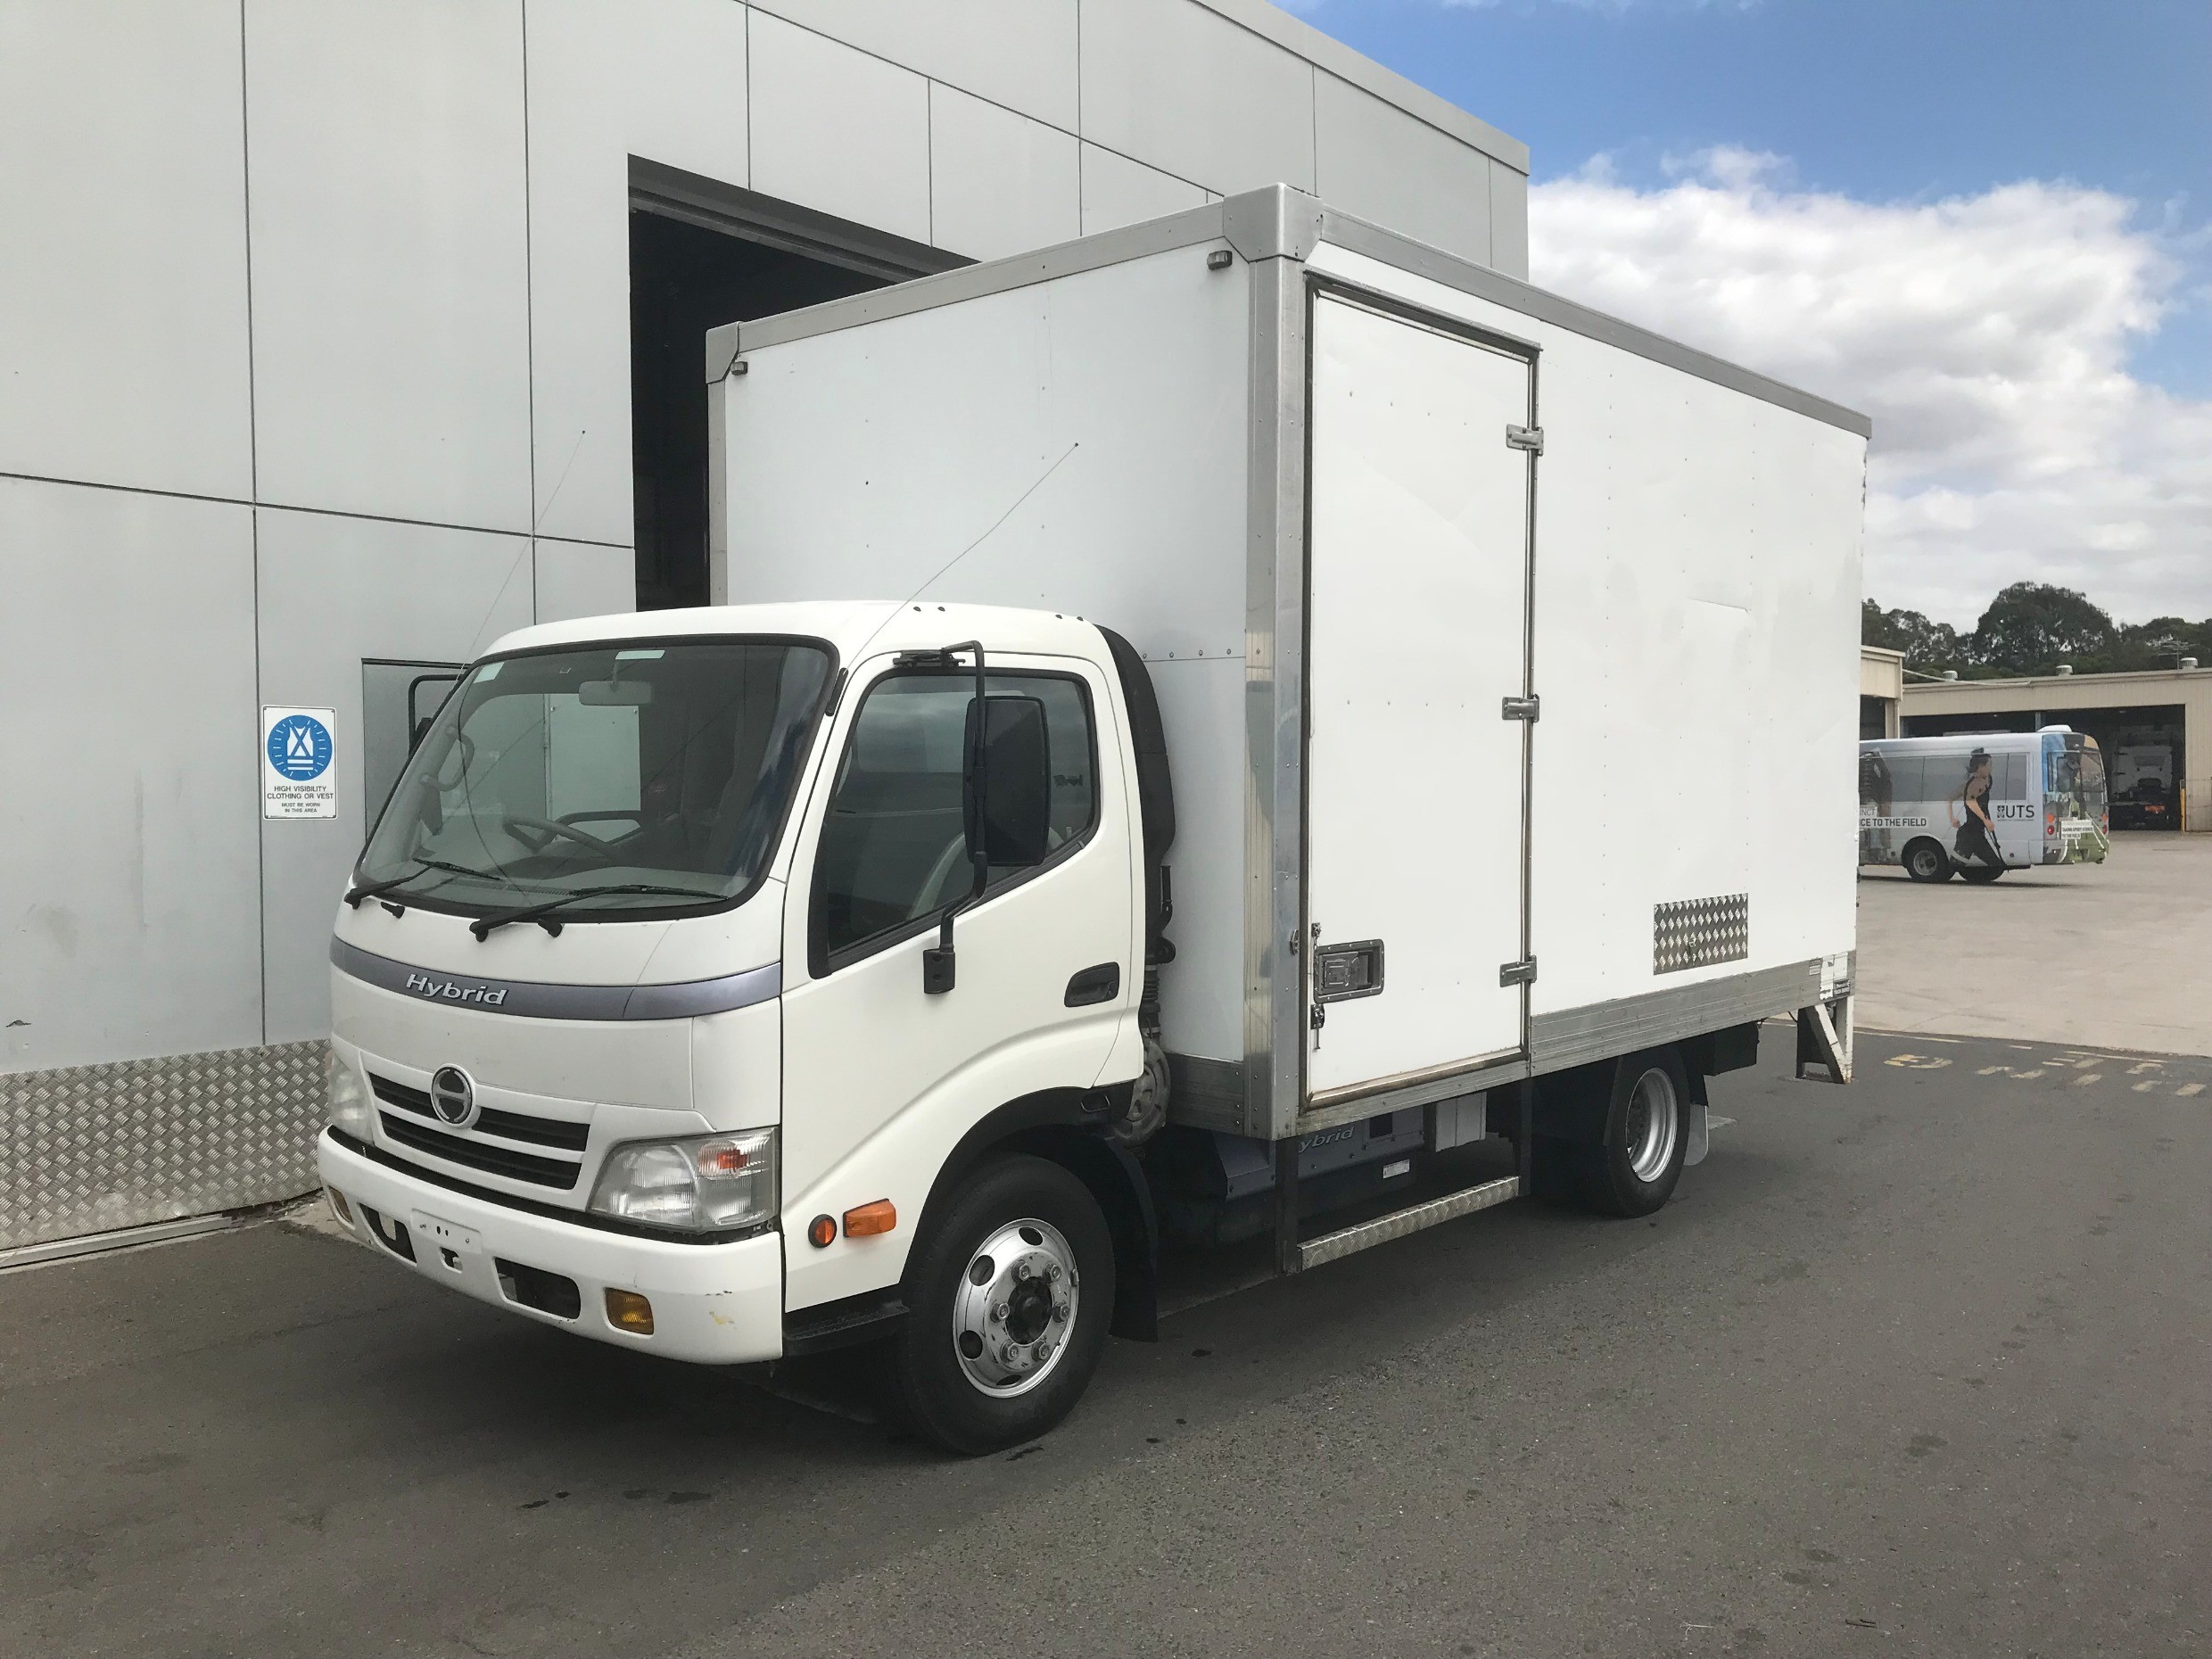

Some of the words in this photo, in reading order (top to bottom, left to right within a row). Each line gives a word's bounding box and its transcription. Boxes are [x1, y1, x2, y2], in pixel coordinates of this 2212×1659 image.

[1860, 808, 1876, 816] INCT
[2005, 805, 2035, 818] UTS
[1860, 818, 1871, 827] CE
[1872, 818, 1883, 827] TO
[1885, 818, 1901, 827] THE
[1902, 818, 1927, 827] FIELD
[406, 973, 508, 1005] Hybrid
[1299, 1125, 1355, 1153] ybrid
